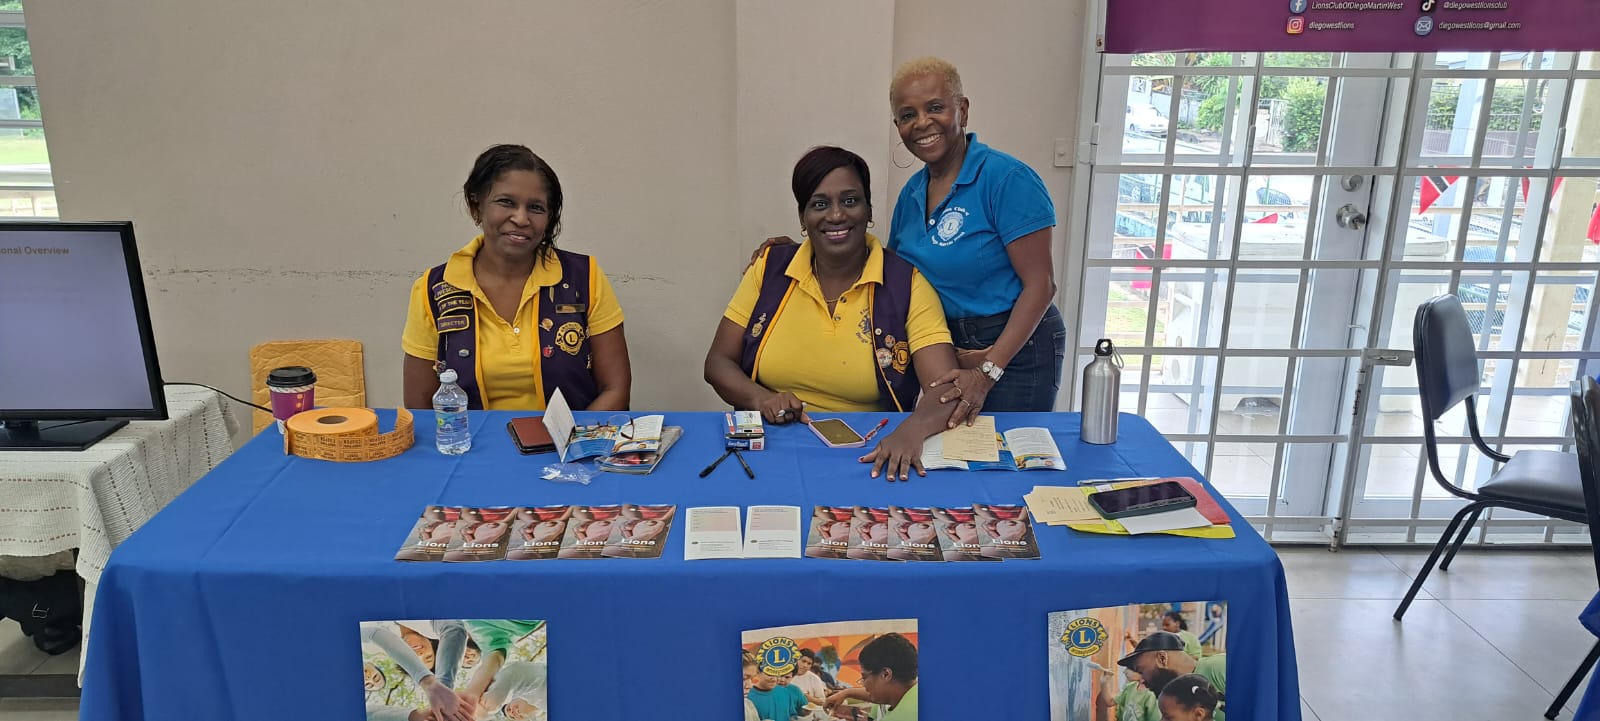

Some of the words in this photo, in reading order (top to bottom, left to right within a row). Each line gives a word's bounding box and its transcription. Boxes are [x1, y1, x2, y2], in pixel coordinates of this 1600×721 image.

[1311, 1, 1404, 10] LionsClubOfDiegoMartinWest
[1443, 1, 1508, 10] @diegowestlionsclub
[1309, 20, 1355, 30] diegowestlions
[1438, 21, 1521, 30] diegowestlions@gmail.com
[24, 246, 69, 255] Overview
[568, 333, 576, 343] L
[620, 538, 656, 546] Lions
[992, 538, 1028, 546] Lions
[1070, 619, 1098, 629] LIONS
[1078, 630, 1091, 644] L
[764, 638, 793, 648] LIONS
[773, 649, 786, 664] L
